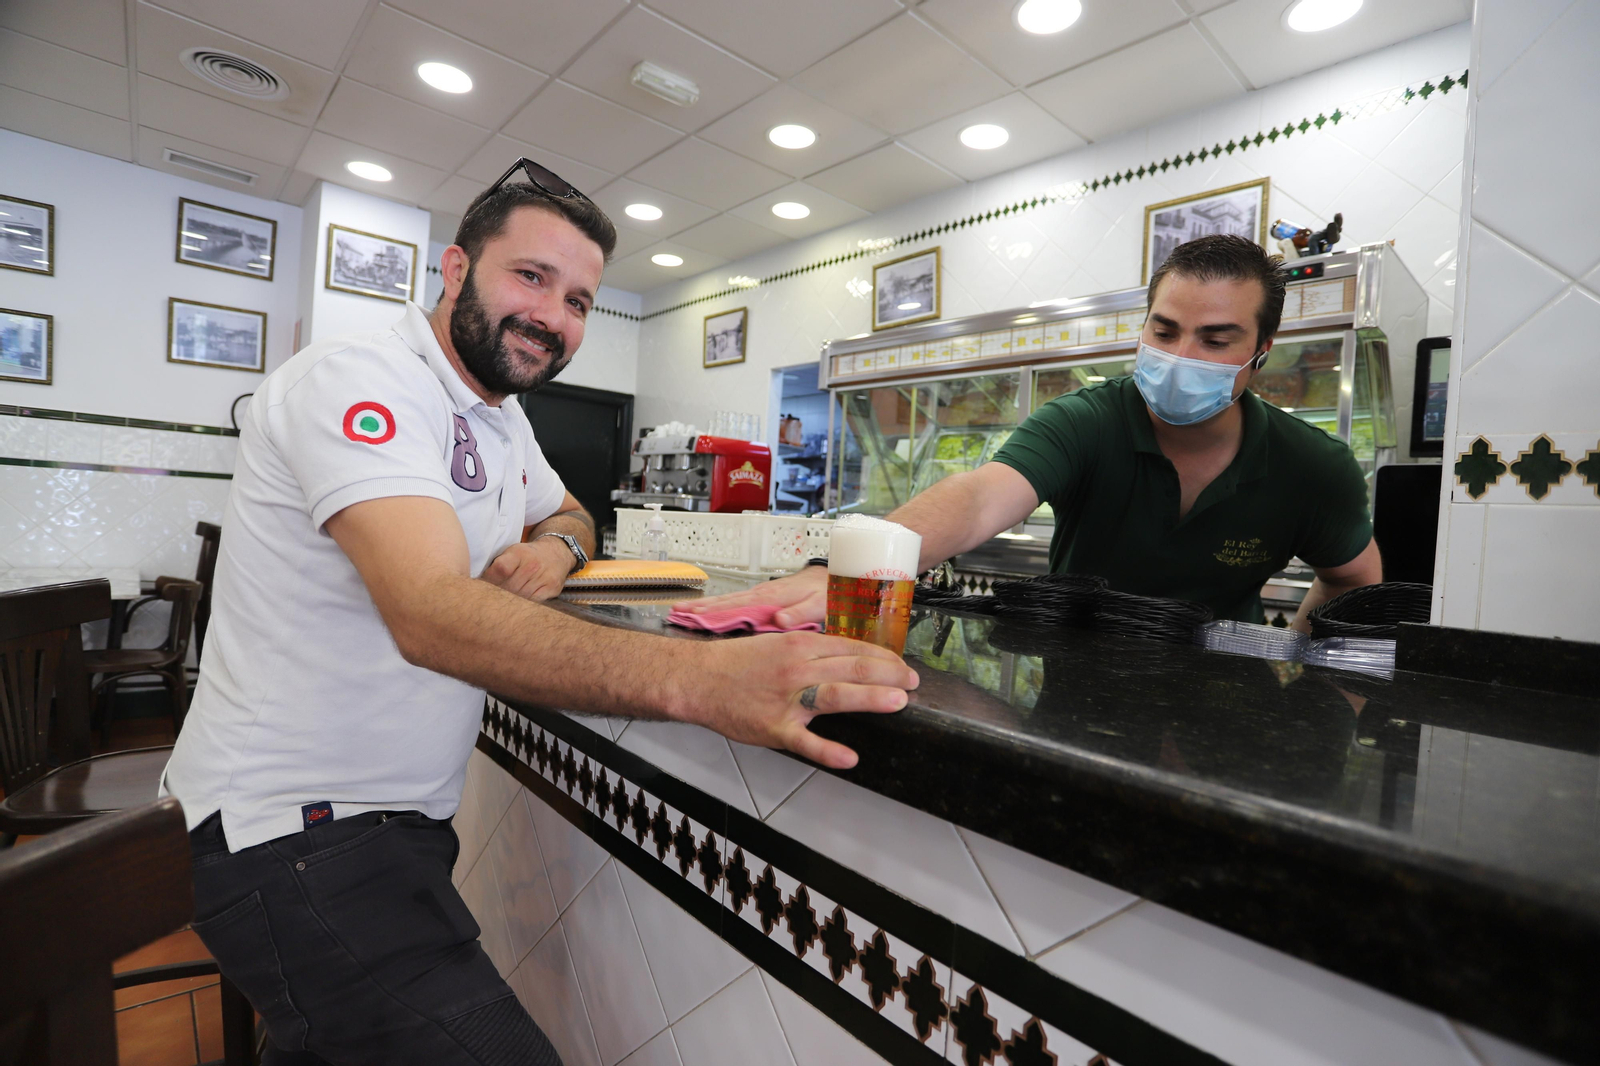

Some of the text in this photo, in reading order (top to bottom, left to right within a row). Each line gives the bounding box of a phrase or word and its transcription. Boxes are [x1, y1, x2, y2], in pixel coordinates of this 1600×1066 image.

[450, 412, 488, 493] 8
[729, 471, 763, 483] SAIMAZA
[1221, 547, 1238, 555] del
[1223, 539, 1257, 551] El Rey
[859, 568, 912, 583] CERVECERI
[858, 588, 875, 596] REY
